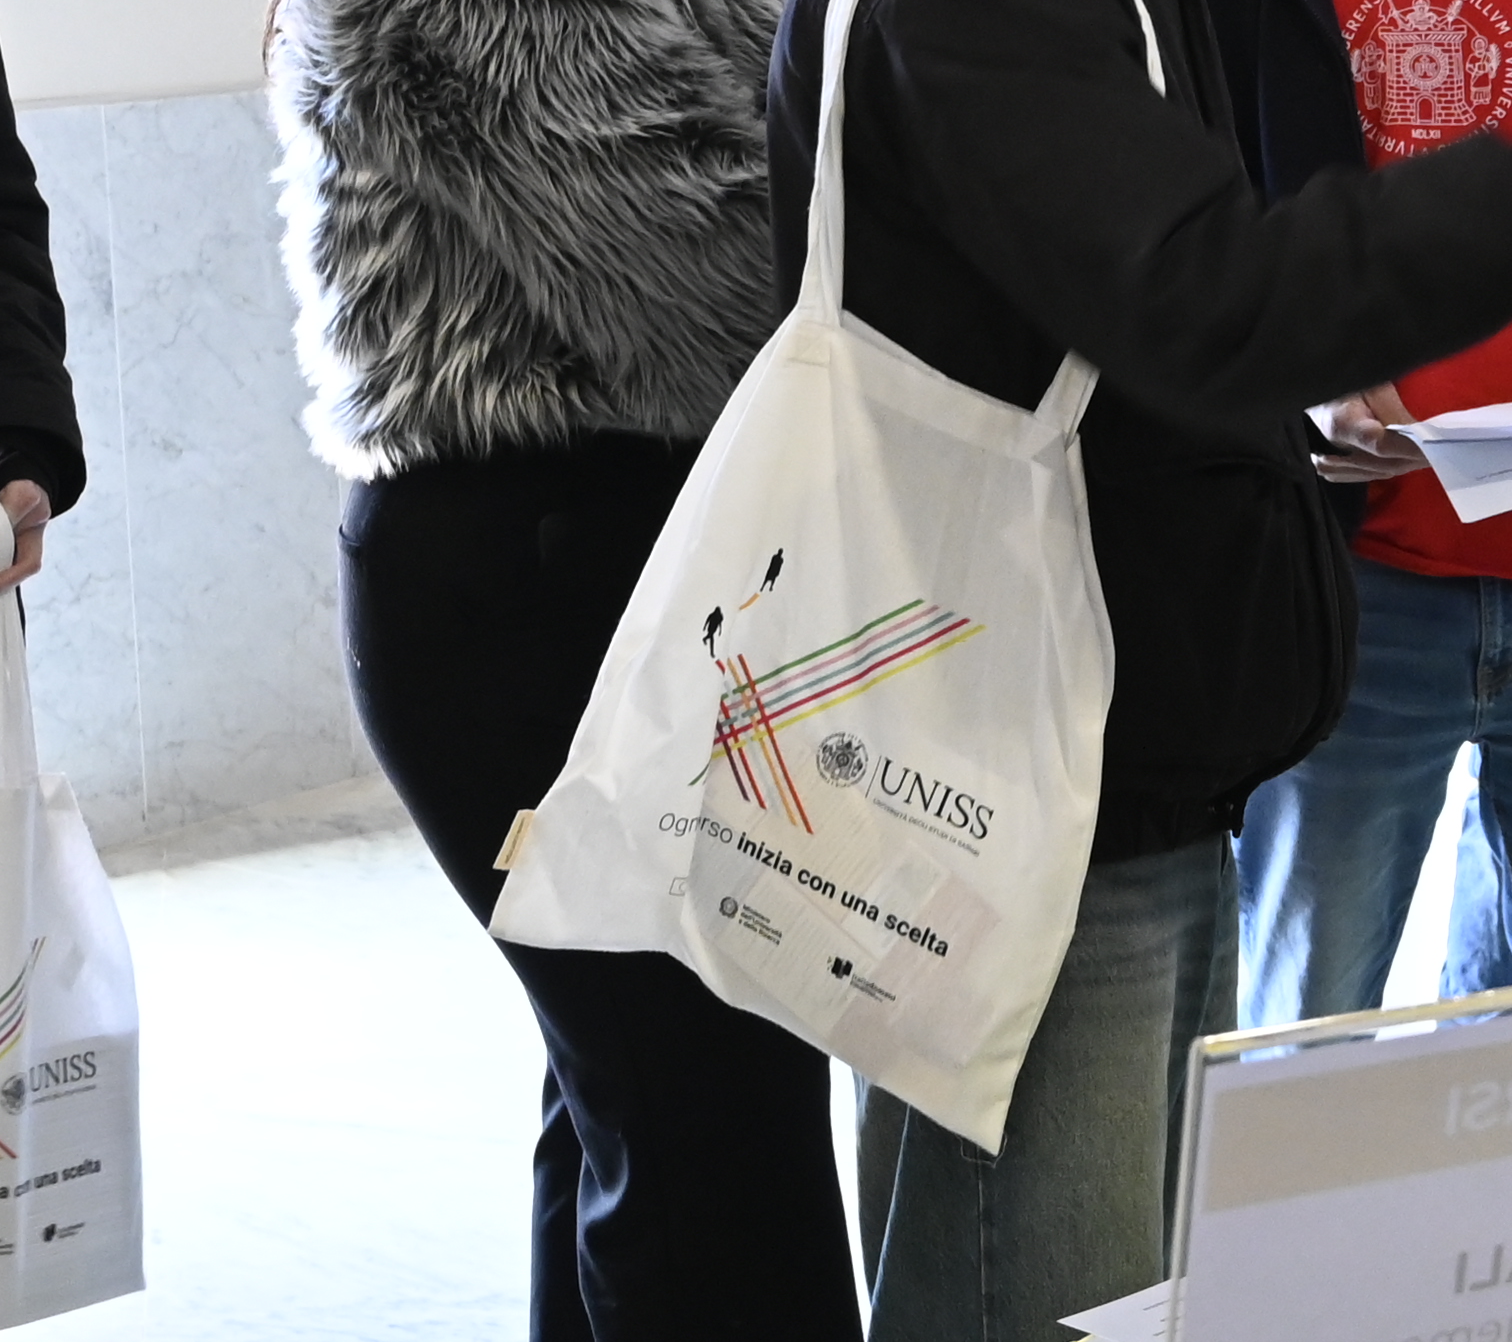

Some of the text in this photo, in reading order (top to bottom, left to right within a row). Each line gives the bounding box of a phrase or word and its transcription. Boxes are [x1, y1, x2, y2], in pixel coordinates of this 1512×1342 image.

[880, 756, 994, 840] UNISS
[737, 832, 793, 876] inizia
[797, 867, 836, 899] con
[841, 891, 879, 922] una
[884, 915, 949, 958] scelta
[29, 1051, 97, 1093] UNISS
